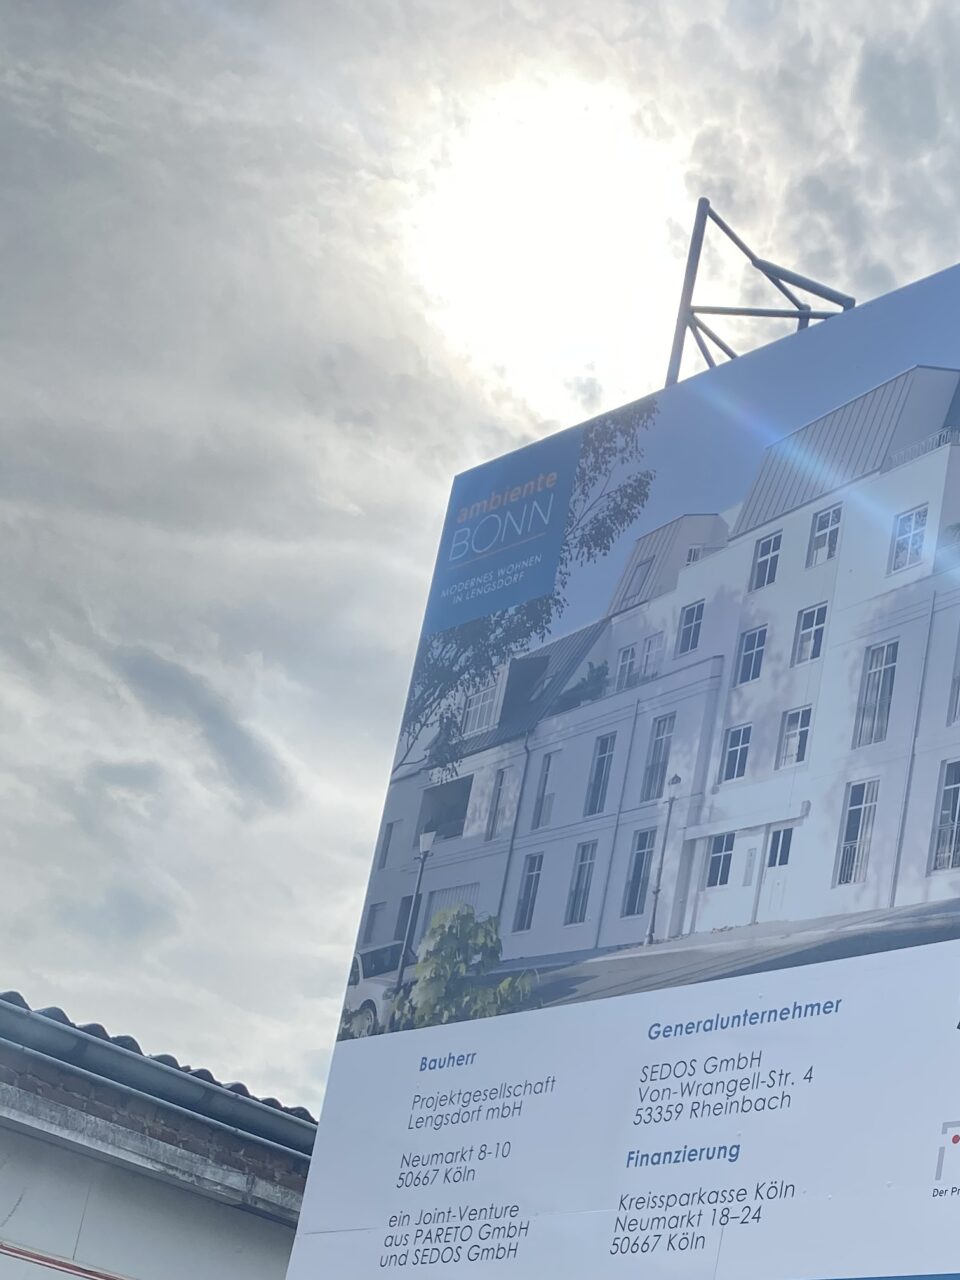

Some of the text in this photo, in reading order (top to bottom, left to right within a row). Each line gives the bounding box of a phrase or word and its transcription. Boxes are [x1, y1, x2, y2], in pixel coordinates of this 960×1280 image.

[457, 471, 558, 523] ambiente
[448, 494, 554, 562] BONN
[441, 553, 542, 599] MODERNES WOHNEN
[452, 571, 525, 605] IN LENGSDORF
[647, 998, 843, 1041] Generalunternehmer
[419, 1052, 477, 1072] Bauherr
[639, 1050, 763, 1083] SEDOS GmbH
[411, 1075, 556, 1112] Projektgesellschaft
[638, 1065, 814, 1103] Von-Wrangell-Str. 4
[407, 1099, 523, 1131] Lengsdorf mbH
[632, 1090, 792, 1126] 53359 Rheinbach
[400, 1141, 511, 1169] Neumarkt 8-10
[626, 1144, 741, 1168] Finanzierung
[396, 1165, 475, 1188] 50667 Köln
[617, 1180, 796, 1212] Kreissparkasse Köln
[932, 1188, 949, 1198] Der
[388, 1203, 520, 1228] ein Joint-Venture
[614, 1211, 703, 1233] Neumarkt
[384, 1220, 530, 1248] aus PARETO GmbH
[609, 1232, 706, 1255] 50667 Köln
[379, 1242, 519, 1268] und SEDOS GmbH
